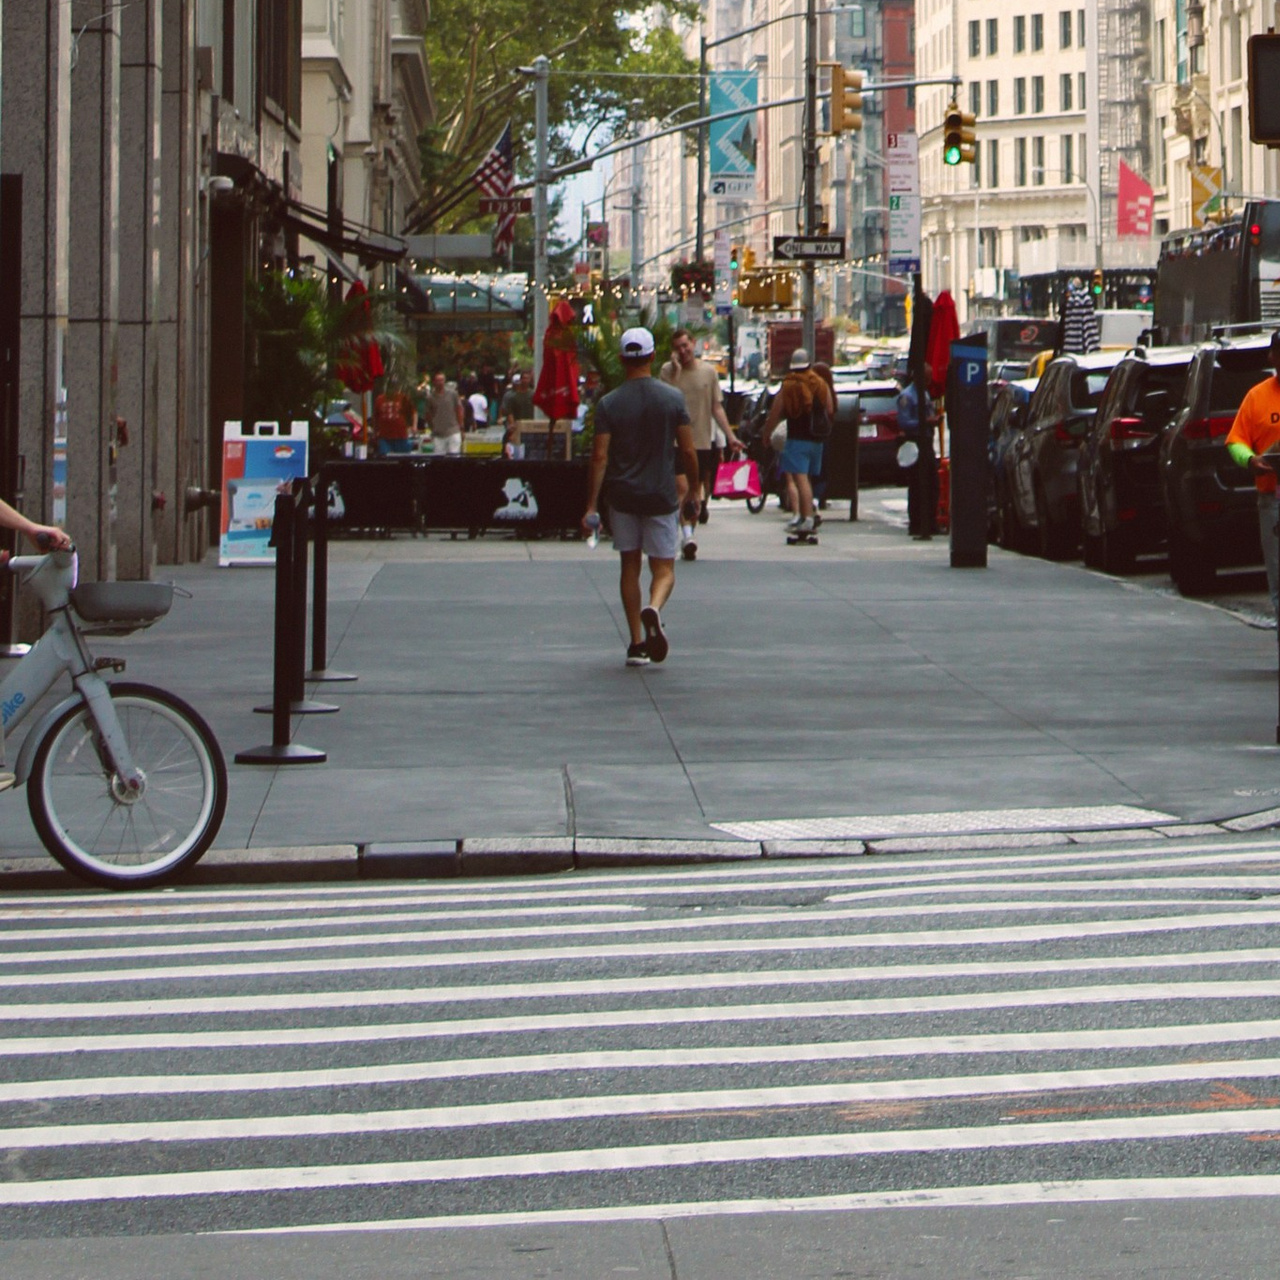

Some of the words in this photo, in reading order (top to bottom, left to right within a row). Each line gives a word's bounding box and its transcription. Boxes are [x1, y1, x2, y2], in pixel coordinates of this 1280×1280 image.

[784, 243, 804, 254] ONE
[816, 243, 837, 254] WAY
[966, 362, 980, 383] P
